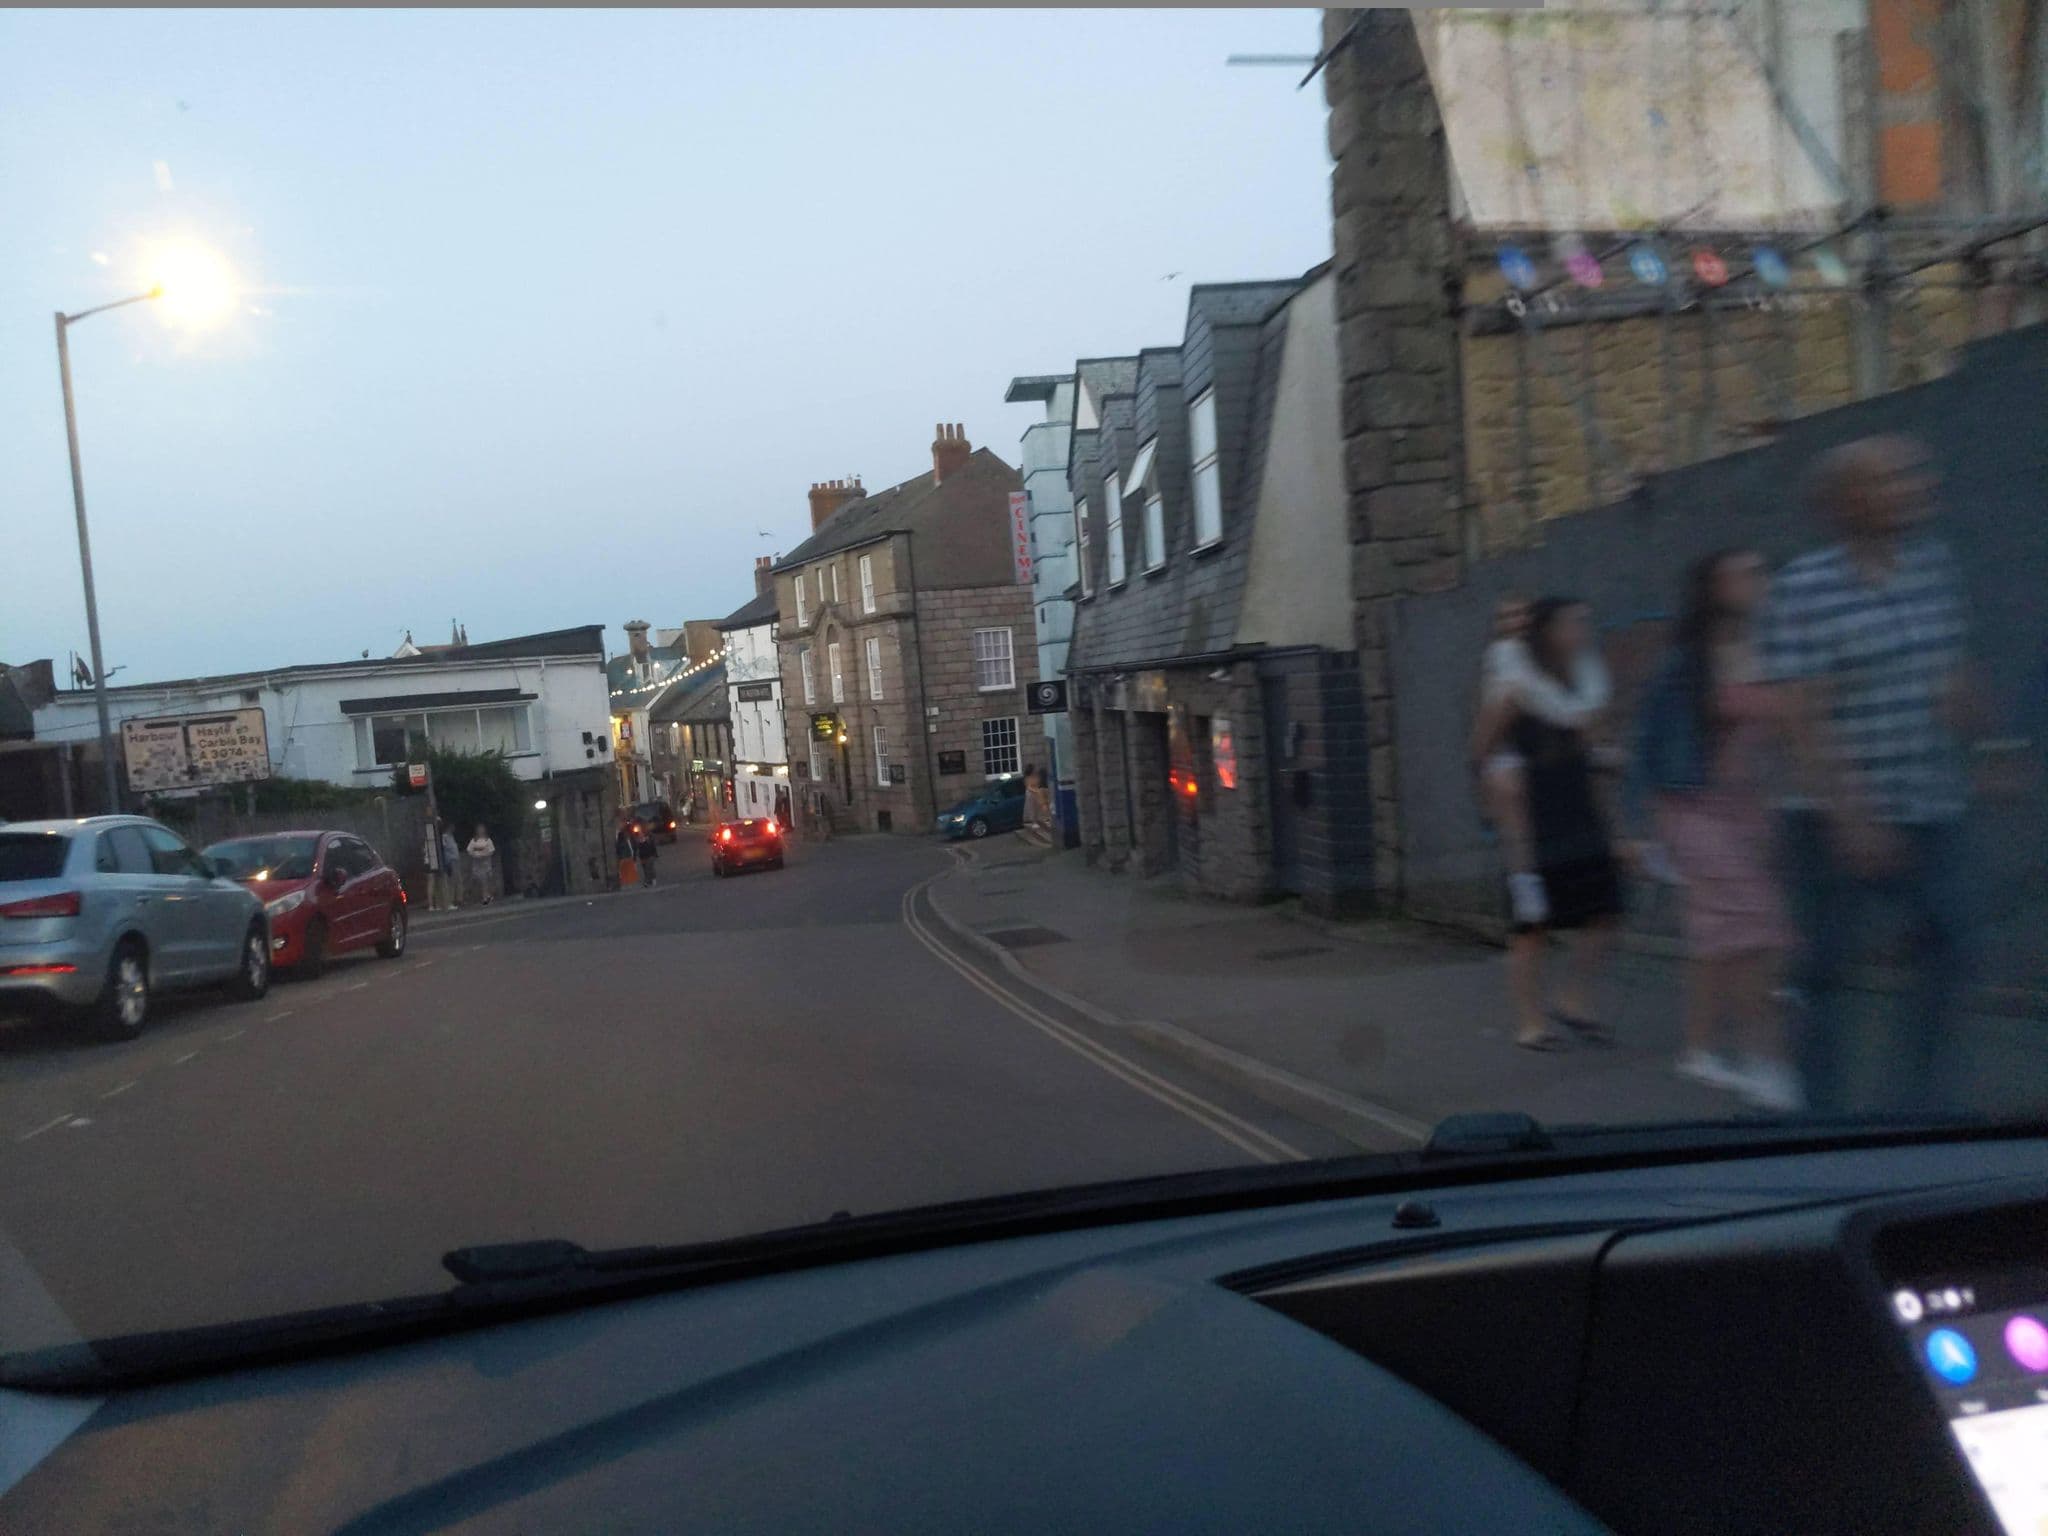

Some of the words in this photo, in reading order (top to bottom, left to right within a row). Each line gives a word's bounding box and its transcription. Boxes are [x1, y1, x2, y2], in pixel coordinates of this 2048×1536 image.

[128, 731, 178, 743] Harbour
[197, 726, 231, 738] Hayle
[199, 737, 237, 749] Carbis
[239, 734, 262, 746] Bay
